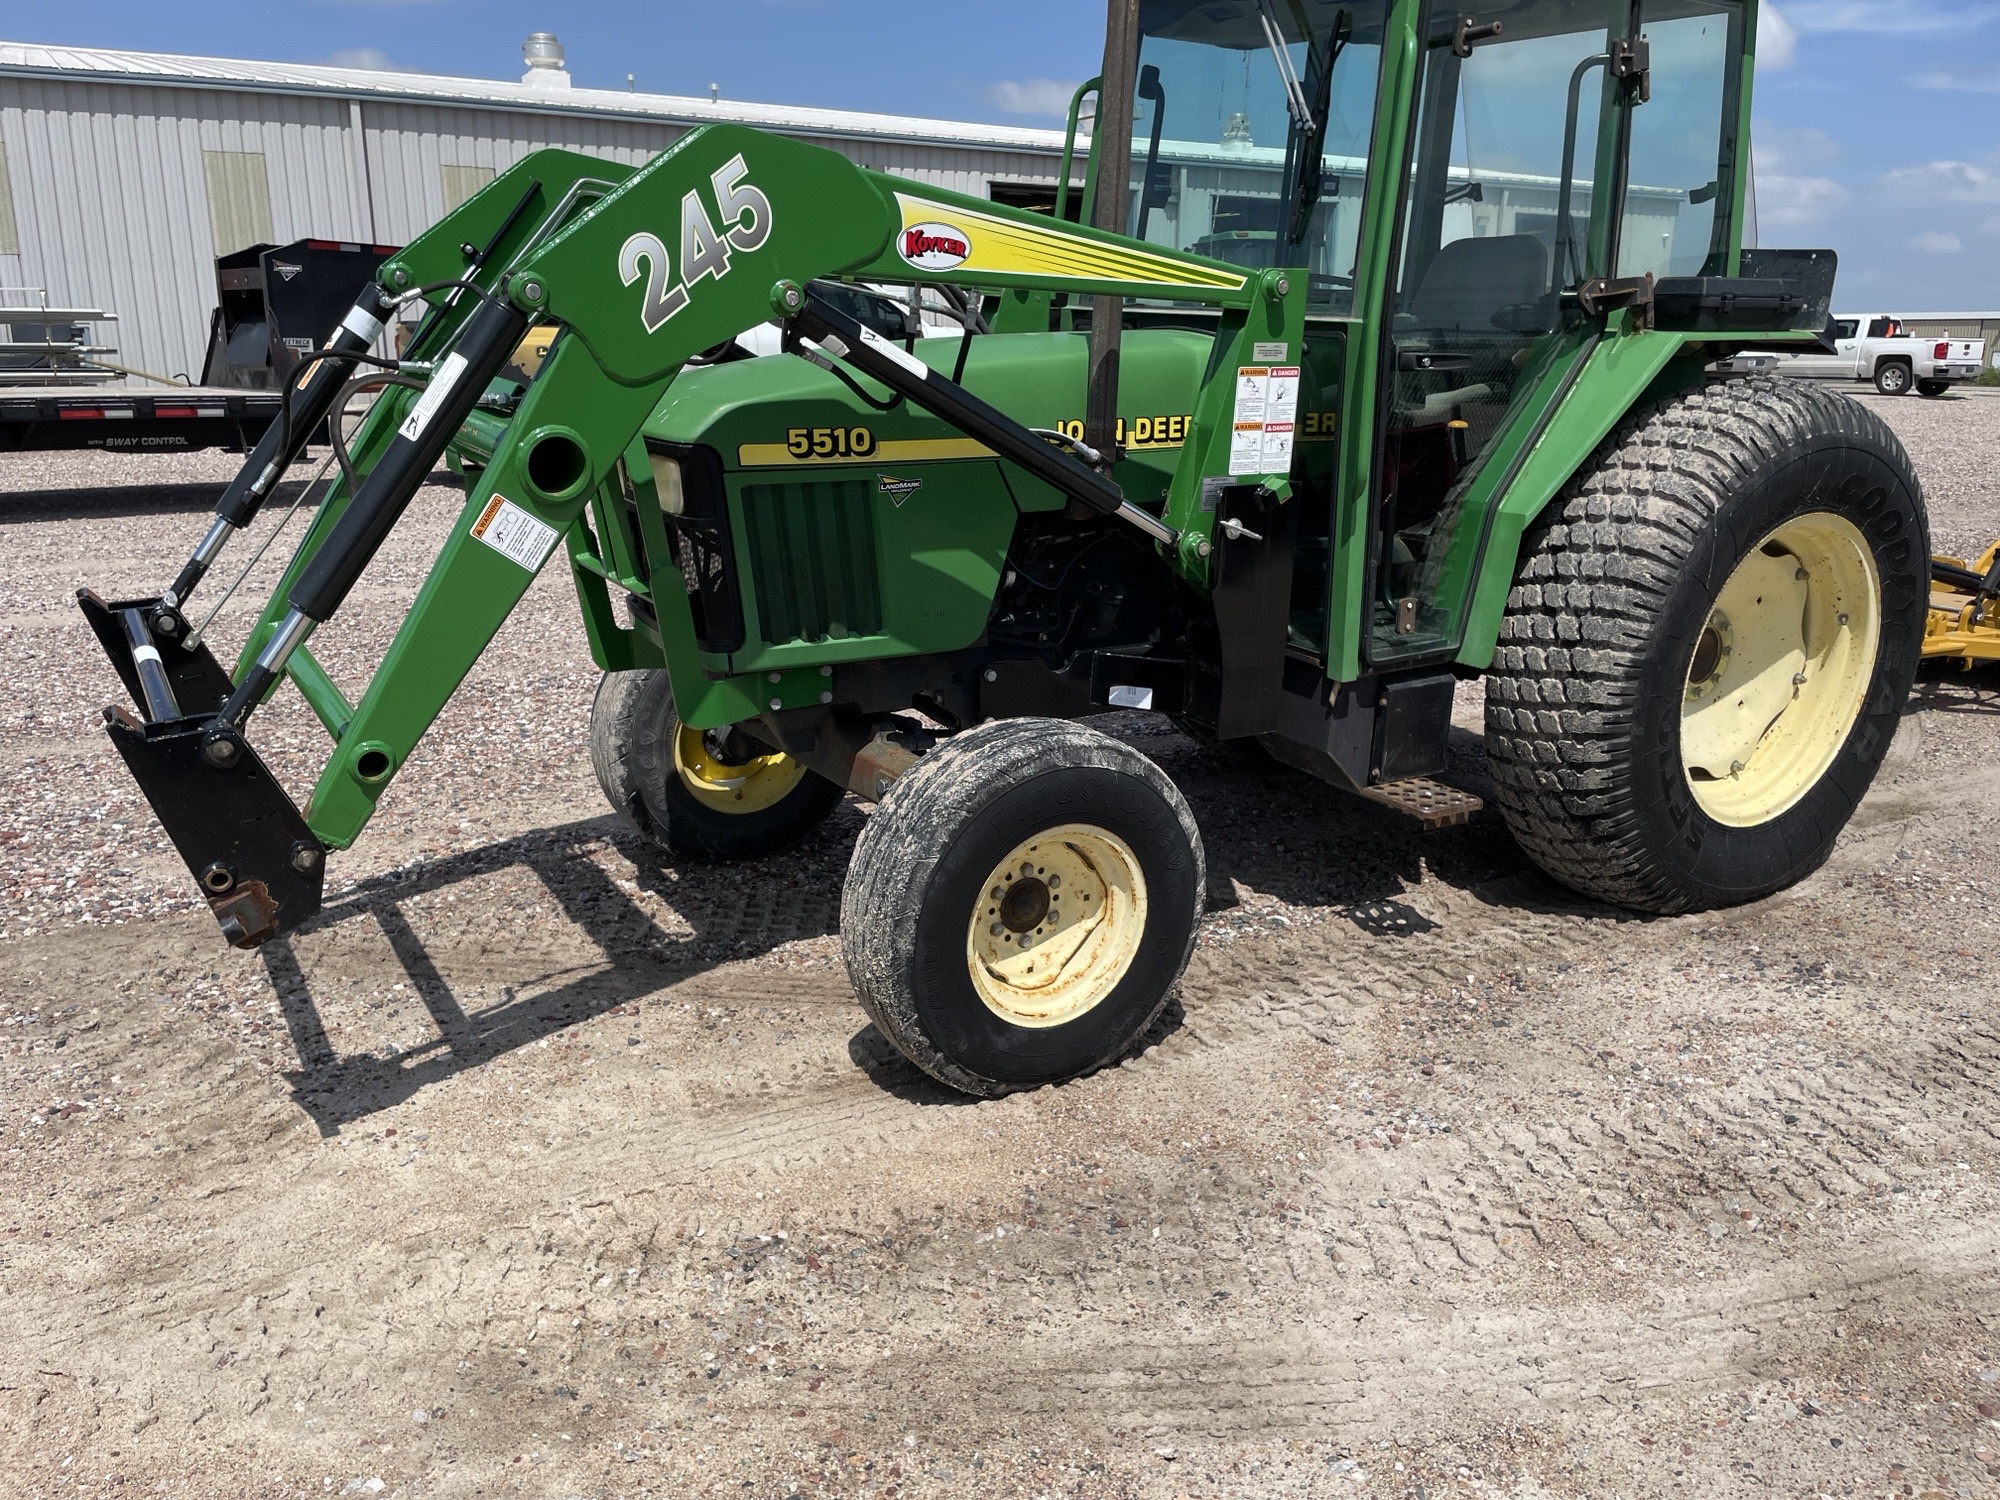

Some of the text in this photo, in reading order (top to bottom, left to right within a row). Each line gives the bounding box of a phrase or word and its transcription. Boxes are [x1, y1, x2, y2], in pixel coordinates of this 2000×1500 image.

[618, 152, 773, 335] 245
[905, 229, 967, 260] KOYKER
[1244, 368, 1268, 376] WARNING
[1278, 369, 1298, 377] DANGER
[106, 437, 139, 447] SWAY
[787, 426, 874, 456] 5510
[1240, 423, 1263, 431] WARNING
[1272, 423, 1293, 432] DANGER
[480, 497, 502, 528] WARNING
[1837, 473, 1918, 764] GOODYEAR
[988, 776, 1178, 850] Firestone
